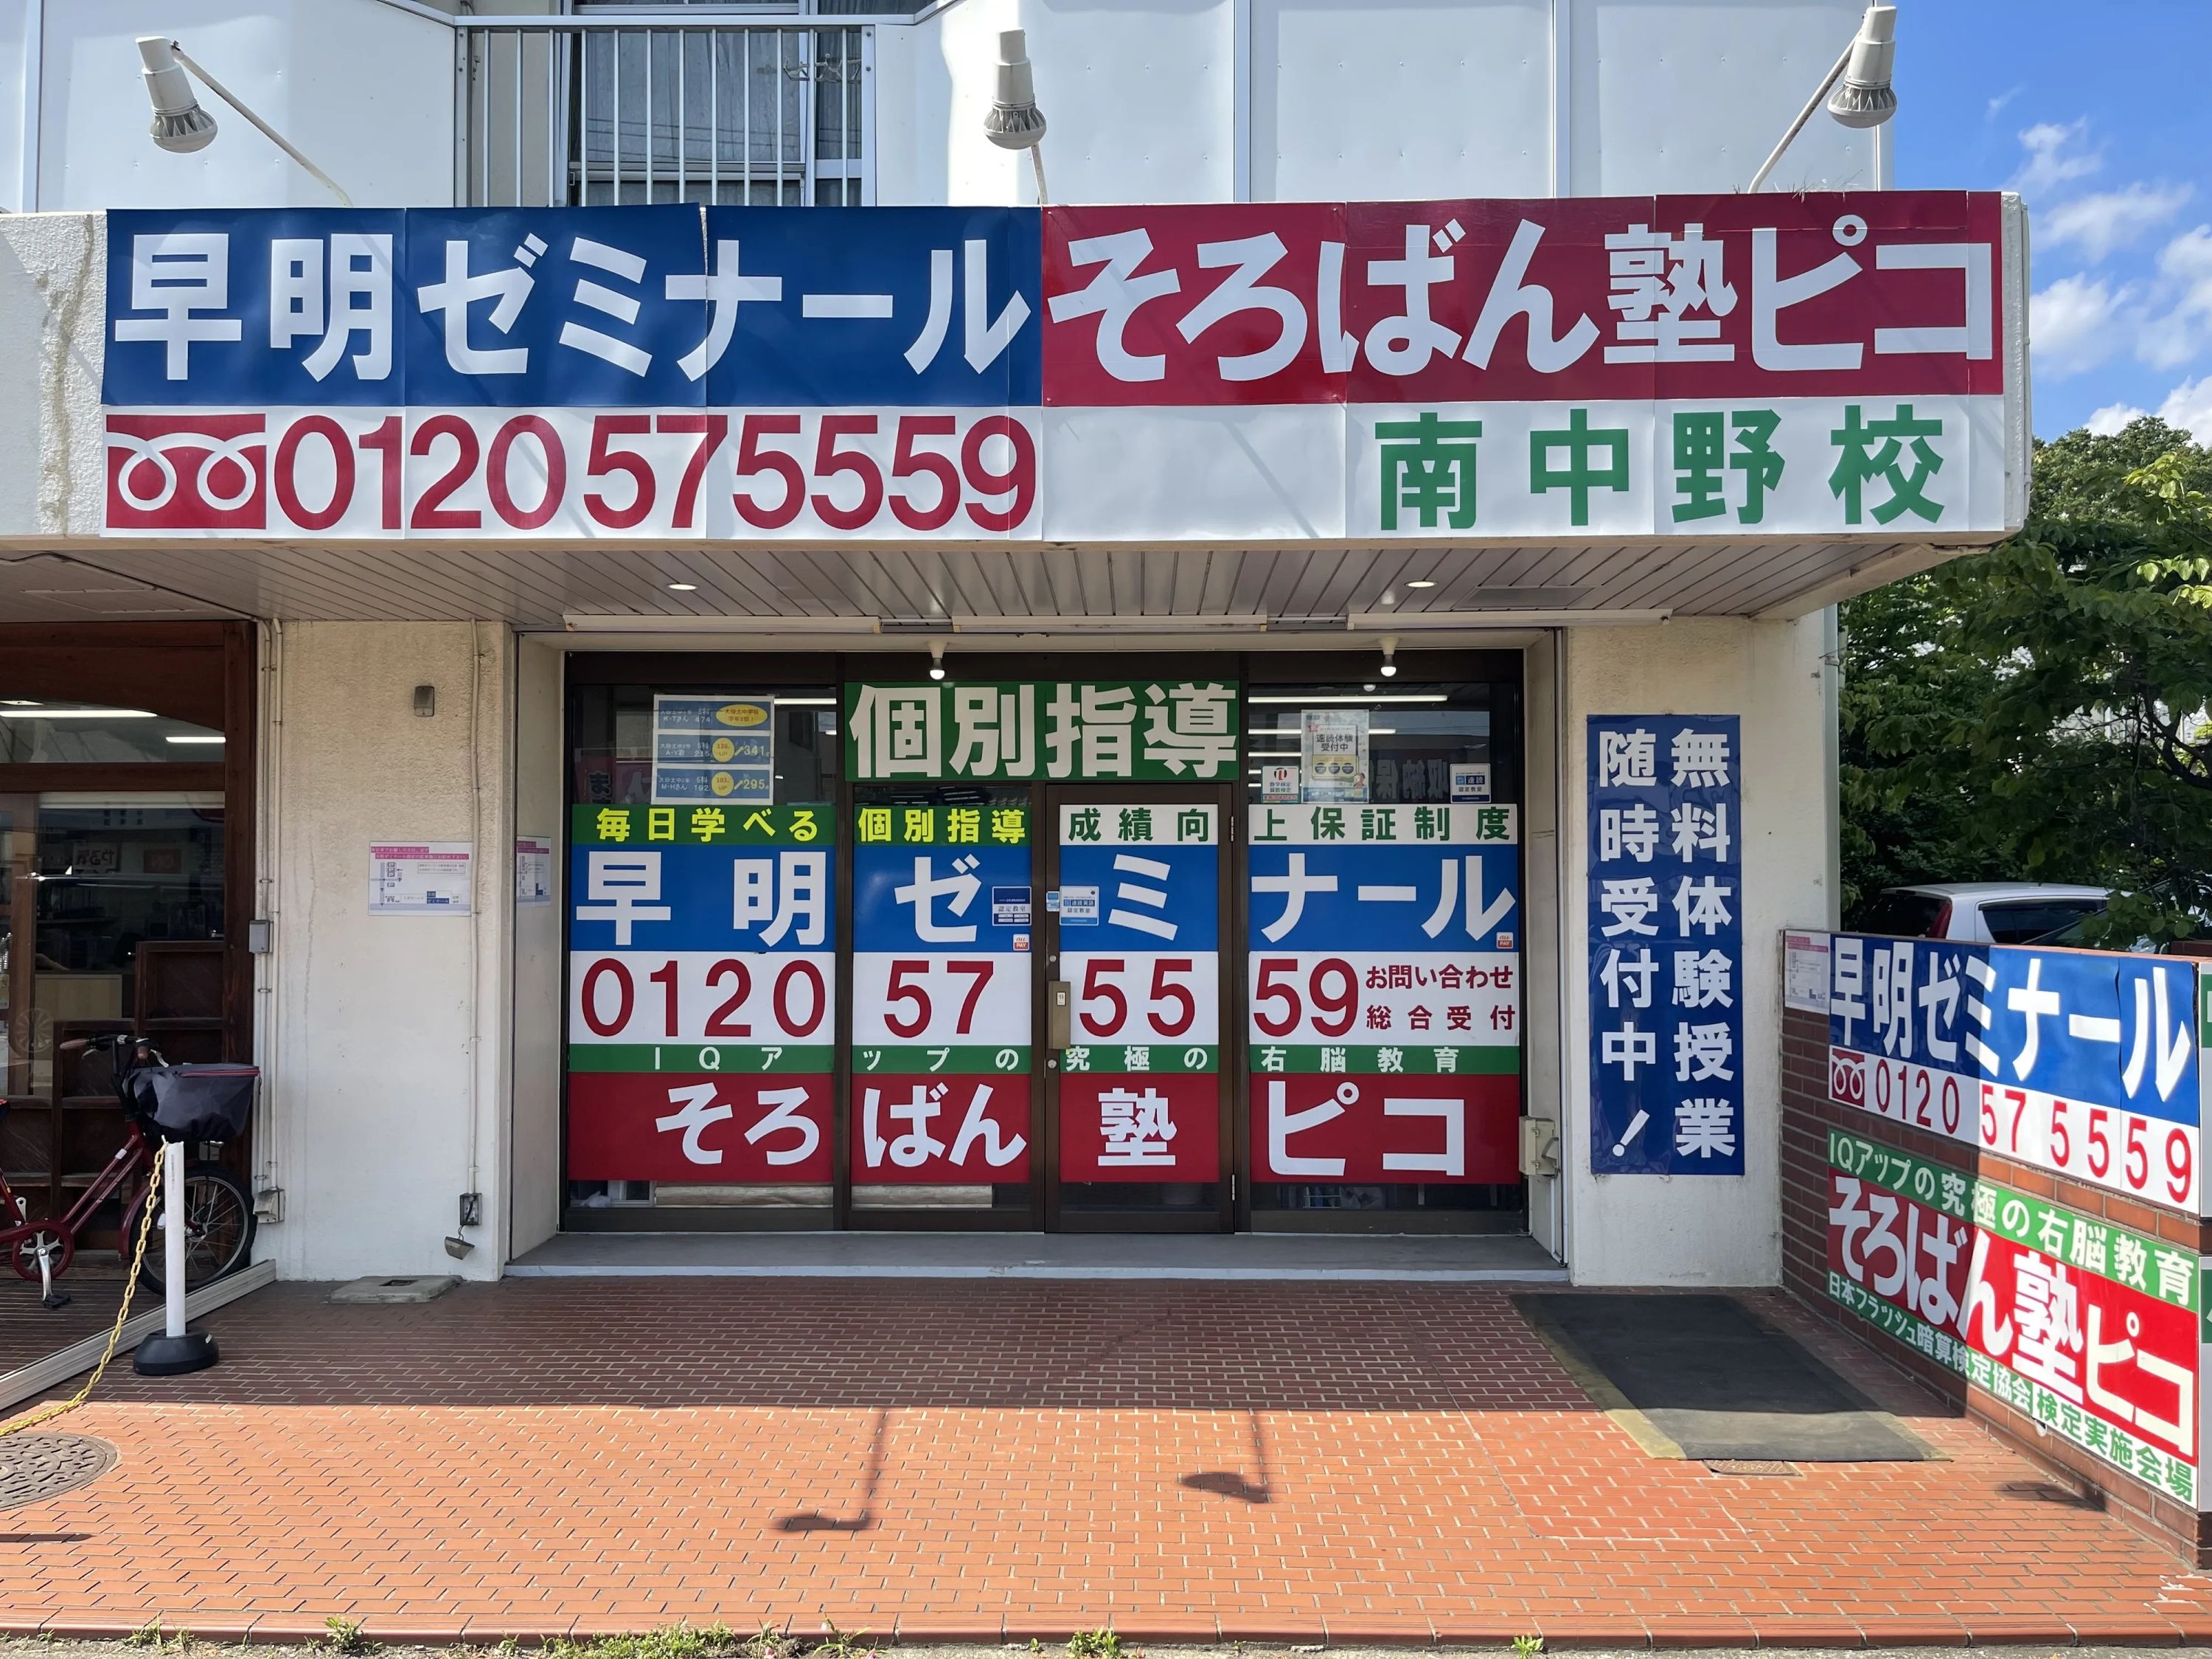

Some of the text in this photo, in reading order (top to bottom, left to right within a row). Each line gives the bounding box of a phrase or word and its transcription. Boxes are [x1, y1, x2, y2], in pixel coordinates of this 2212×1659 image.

[116, 233, 1031, 381] 早明ゼミナール
[1048, 215, 1993, 382] そろばん塾ピコ
[1375, 405, 1944, 530] 南中野校
[743, 745, 769, 757] 341
[849, 683, 1237, 779] 個別指導
[1321, 743, 1349, 751] 受付中
[597, 808, 1026, 844] 毎日学べる 個別指導
[743, 779, 769, 789] 295
[1366, 964, 1513, 990] お問い合わせ
[1671, 728, 1736, 1159] 無料体験授業
[581, 958, 825, 1037] 0120
[883, 960, 994, 1038] 57
[1366, 1005, 1515, 1031] 総合受付
[1831, 937, 2191, 1102] 早明ゼミナール
[1876, 1059, 1960, 1134] 0120
[1829, 1133, 2194, 1306] IQアップの究極の右脳教育
[1829, 1176, 2194, 1457] そろばん塾ピコ
